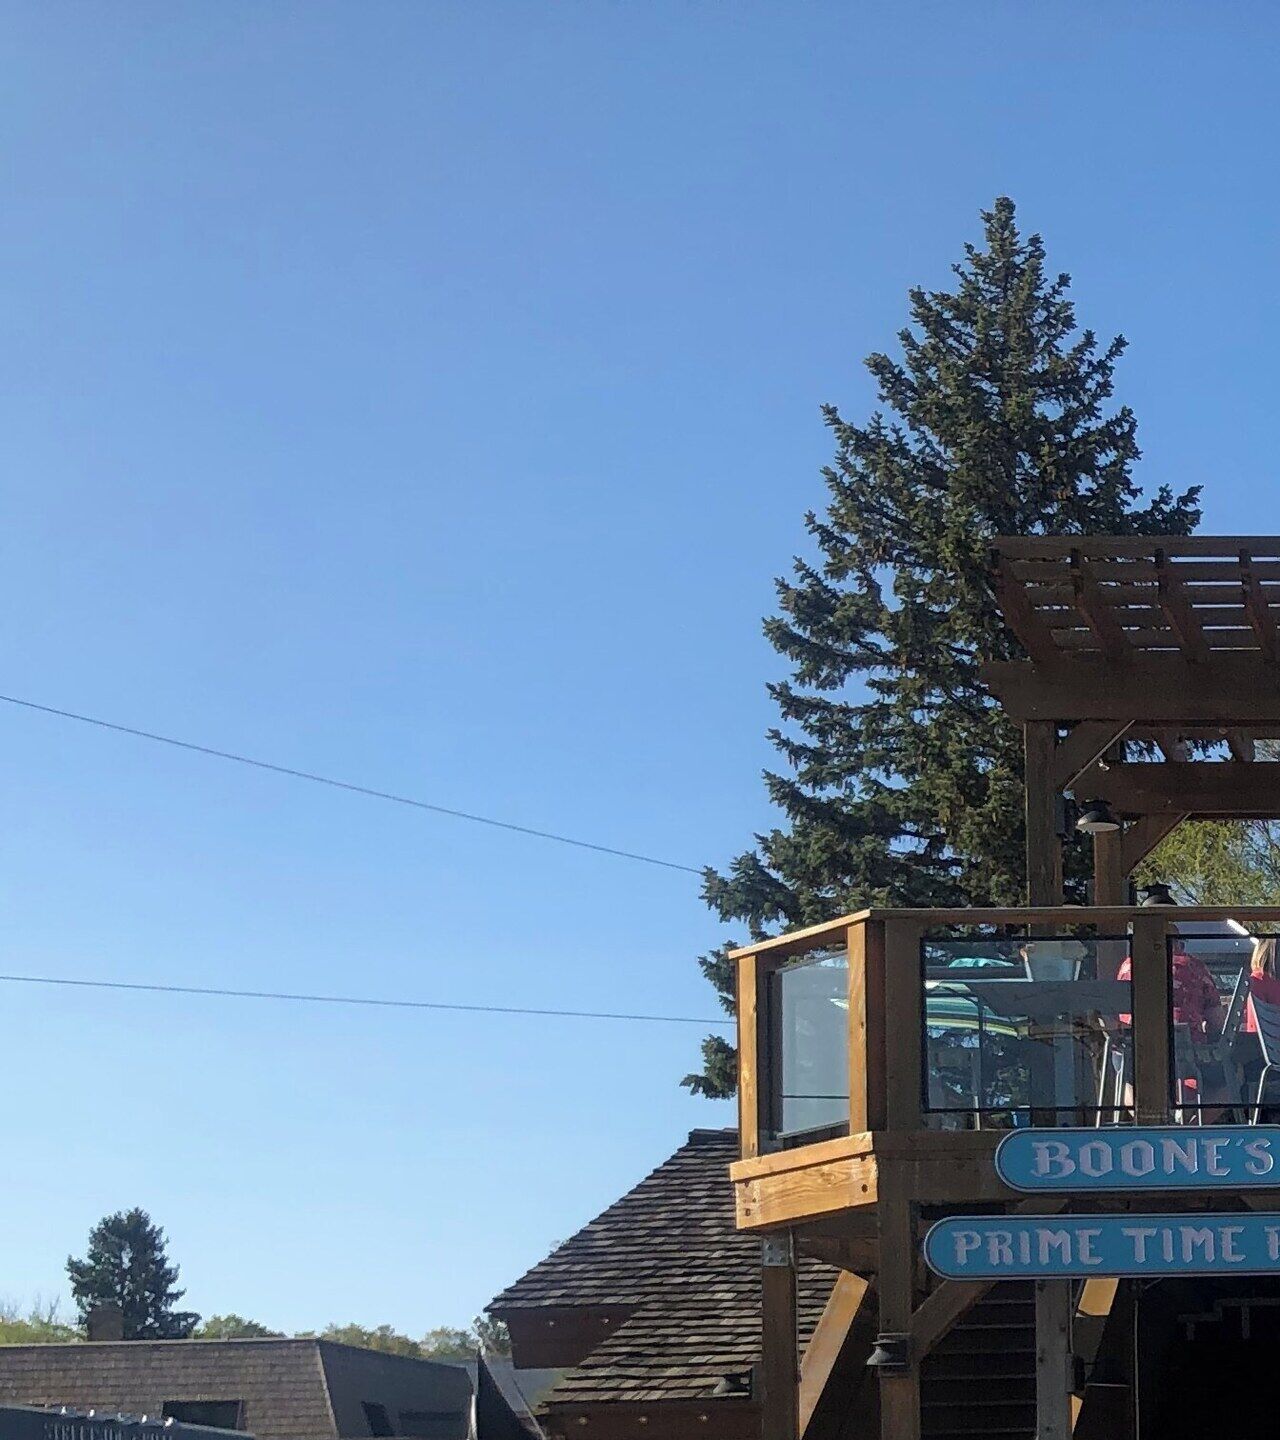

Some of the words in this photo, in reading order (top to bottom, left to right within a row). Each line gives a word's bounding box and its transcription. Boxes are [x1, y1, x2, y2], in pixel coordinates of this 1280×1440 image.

[1031, 1137, 1274, 1179] BOONE'S
[951, 1226, 1103, 1266] PRIME
[1121, 1225, 1247, 1264] TIME
